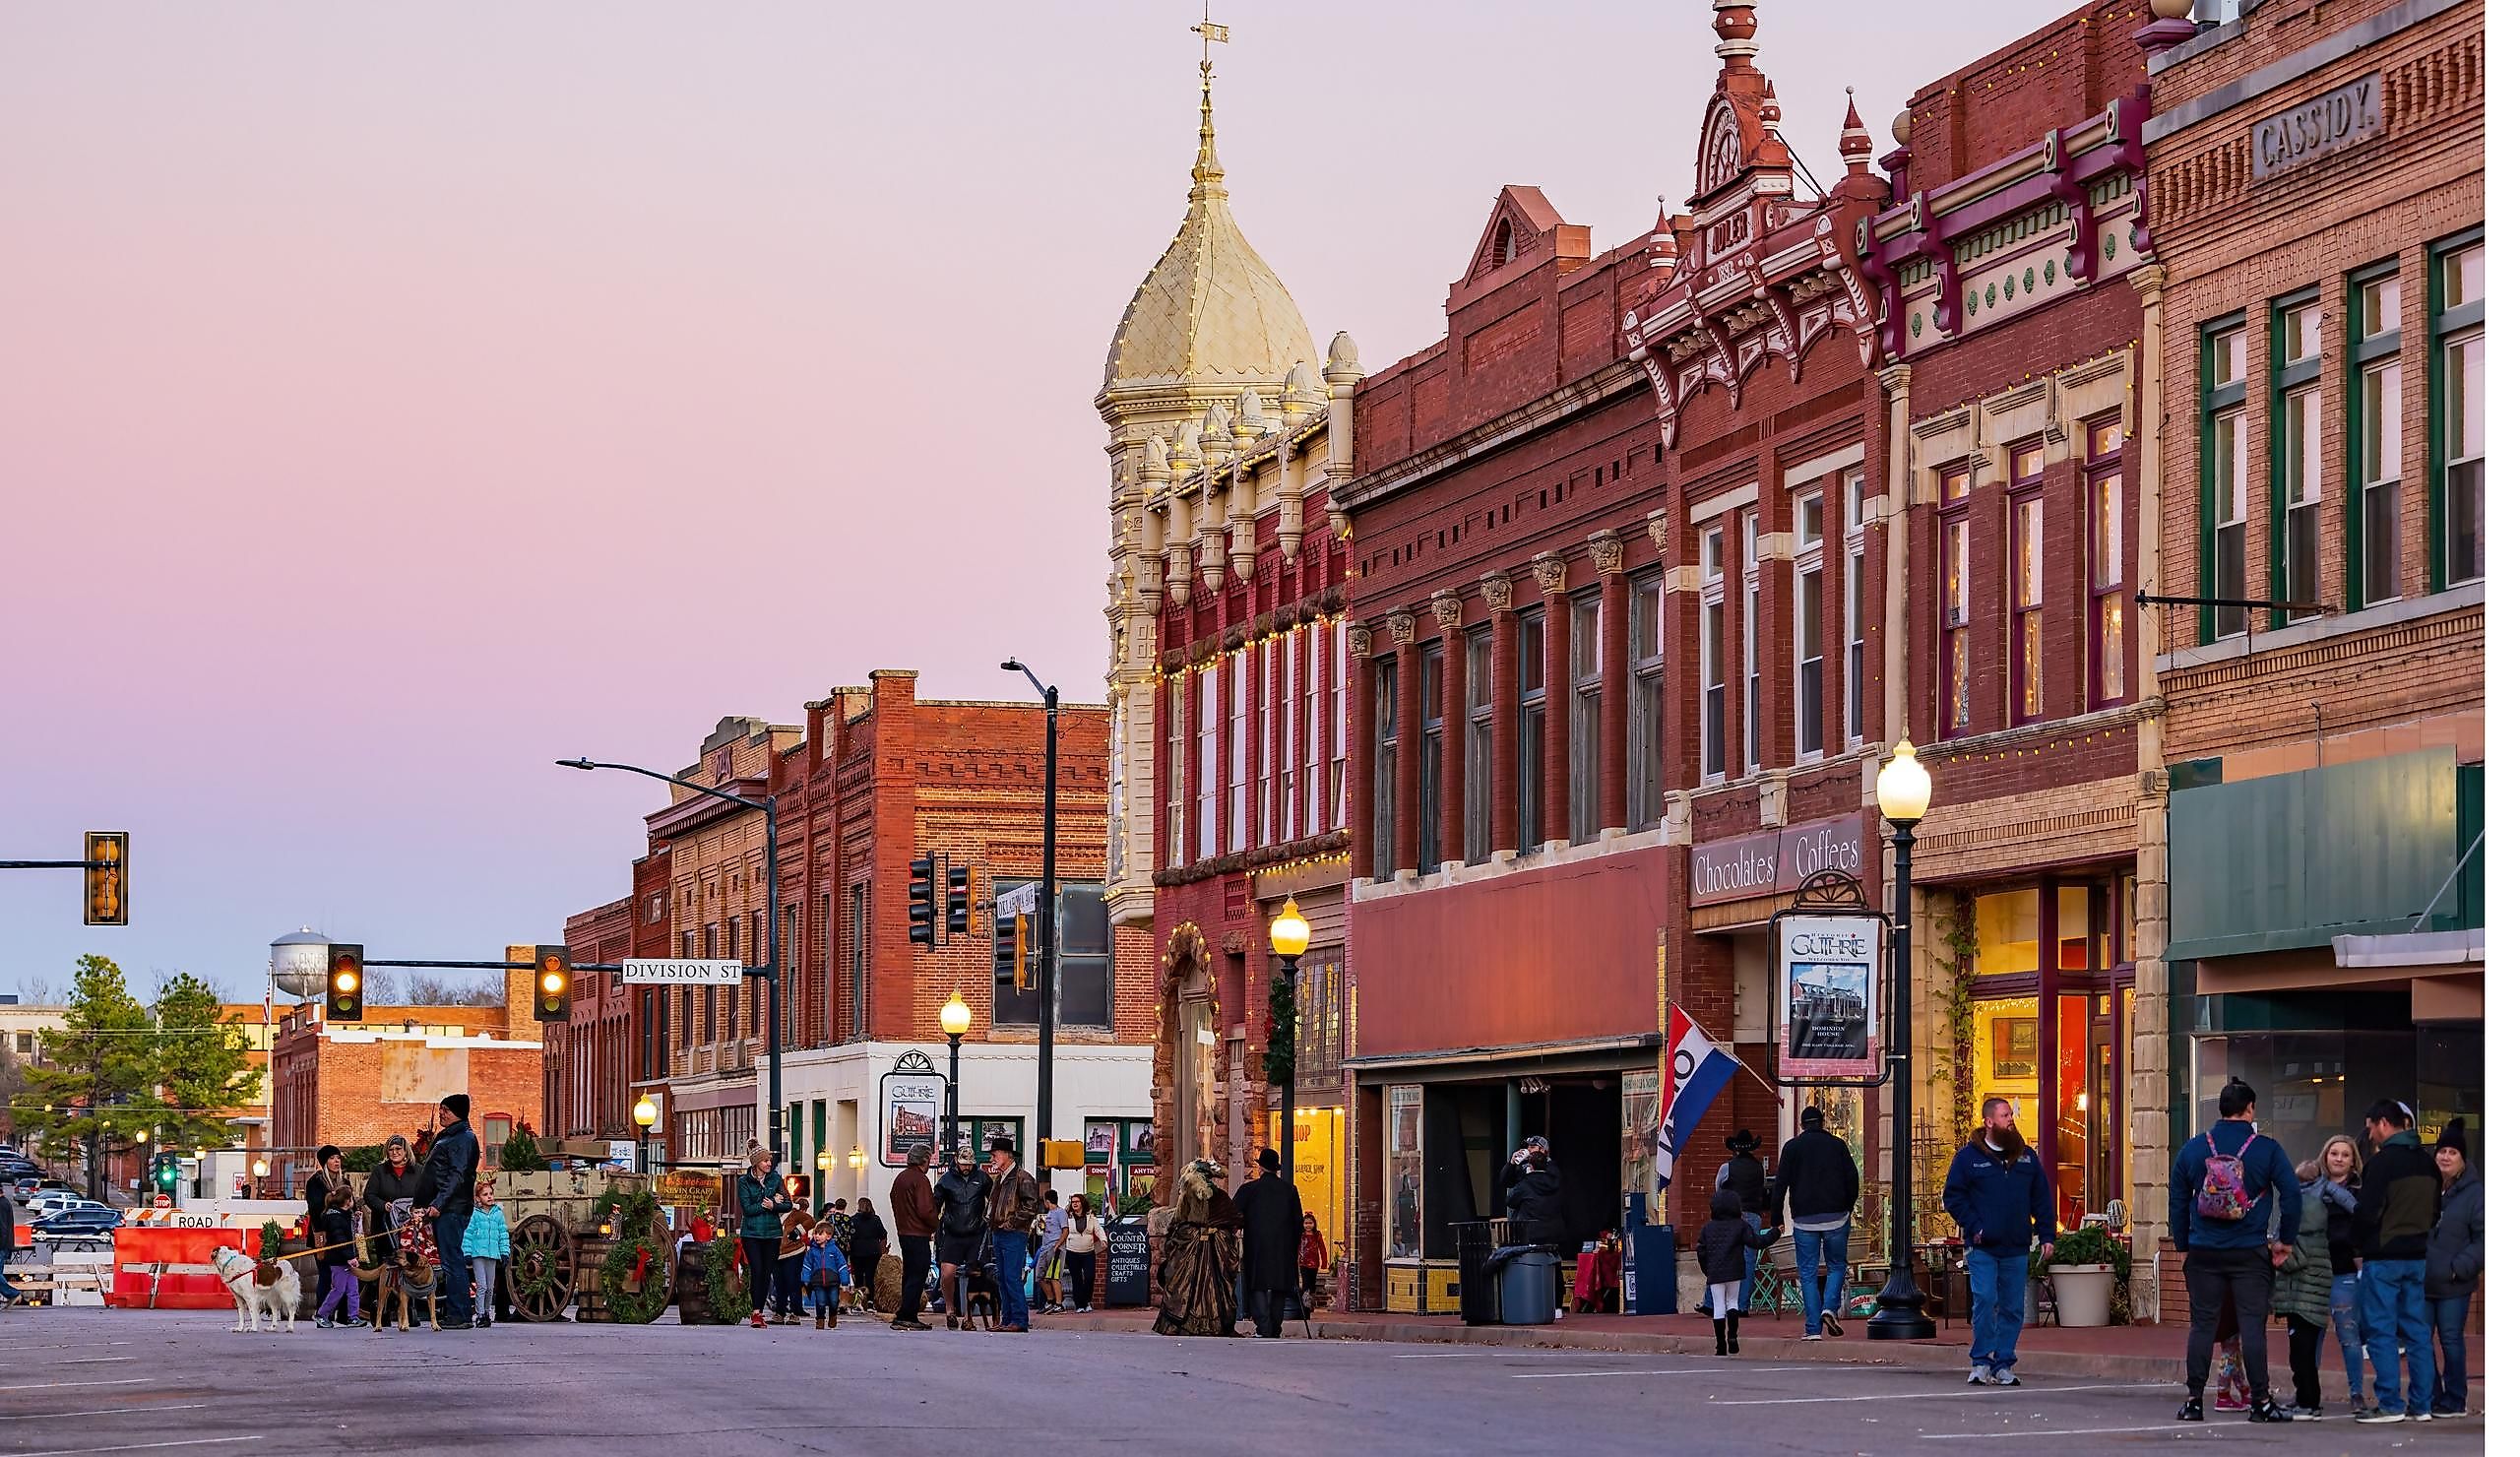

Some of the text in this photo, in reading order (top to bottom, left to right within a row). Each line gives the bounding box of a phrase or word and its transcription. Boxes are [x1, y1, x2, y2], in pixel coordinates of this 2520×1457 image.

[1712, 211, 1748, 255] ADLER
[1695, 829, 1858, 896] Chocolates Coffees
[1791, 933, 1867, 958] GUTHRIE
[624, 964, 741, 979] DIVISION ST
[178, 1217, 213, 1228] ROAD
[1108, 1231, 1149, 1242] COUNTRY
[1110, 1242, 1147, 1254] CORNER
